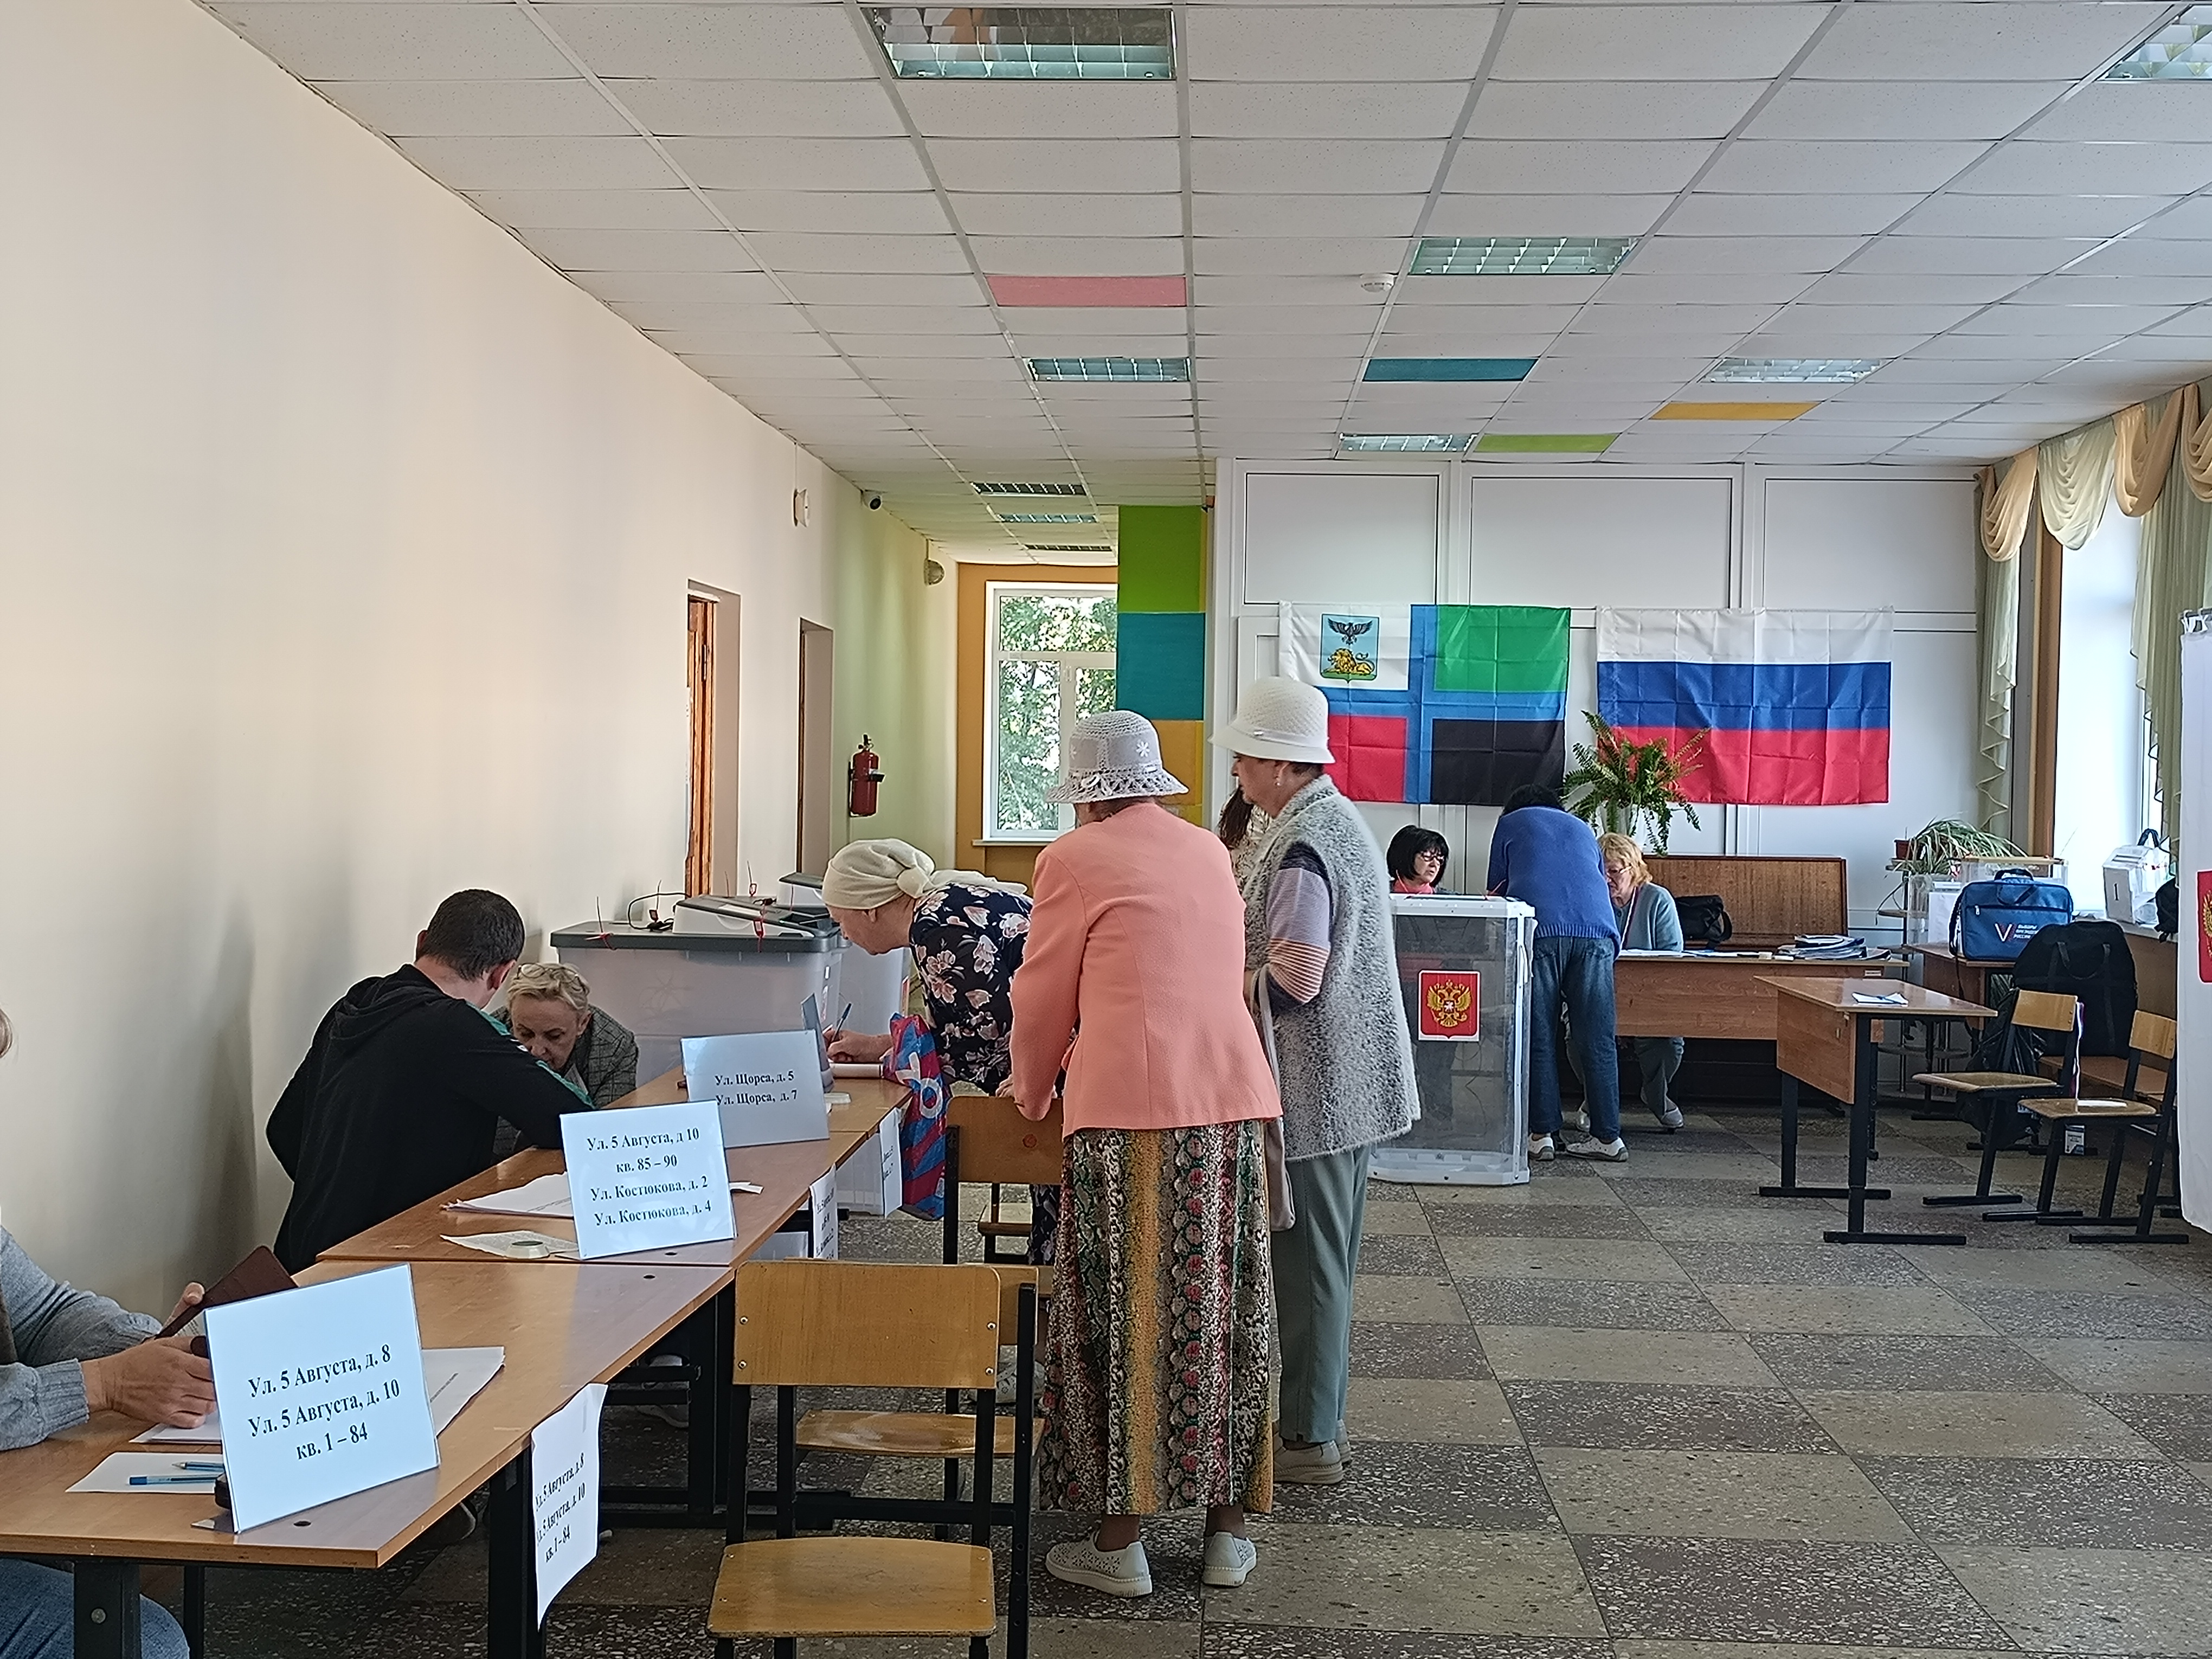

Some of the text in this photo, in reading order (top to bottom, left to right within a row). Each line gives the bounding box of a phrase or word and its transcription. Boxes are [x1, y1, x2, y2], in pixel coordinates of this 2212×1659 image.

[2114, 883, 2119, 901] 1
[715, 1070, 794, 1086] Ул. Щорса, д. 5
[716, 1089, 798, 1106] Ул. Щорса, д. 7
[587, 1127, 700, 1151] Ул. 5 Августа, д 10
[616, 1162, 635, 1173] кв.
[637, 1157, 652, 1171] 85
[664, 1154, 678, 1168] 90
[590, 1175, 709, 1201] Ул. Костюкова, д. 2
[594, 1199, 711, 1226] Ул. Костюкова, д. 4
[248, 1343, 391, 1398] Ул. 5 Августа, д. 8
[248, 1379, 400, 1437] Ул. 5 Августа, д. 10
[296, 1442, 321, 1461] кв.
[324, 1432, 333, 1452] 1
[349, 1422, 368, 1444] 84
[580, 1452, 584, 1468] 8
[578, 1482, 586, 1501] 10
[554, 1536, 558, 1553] 1
[562, 1524, 570, 1544] 84
